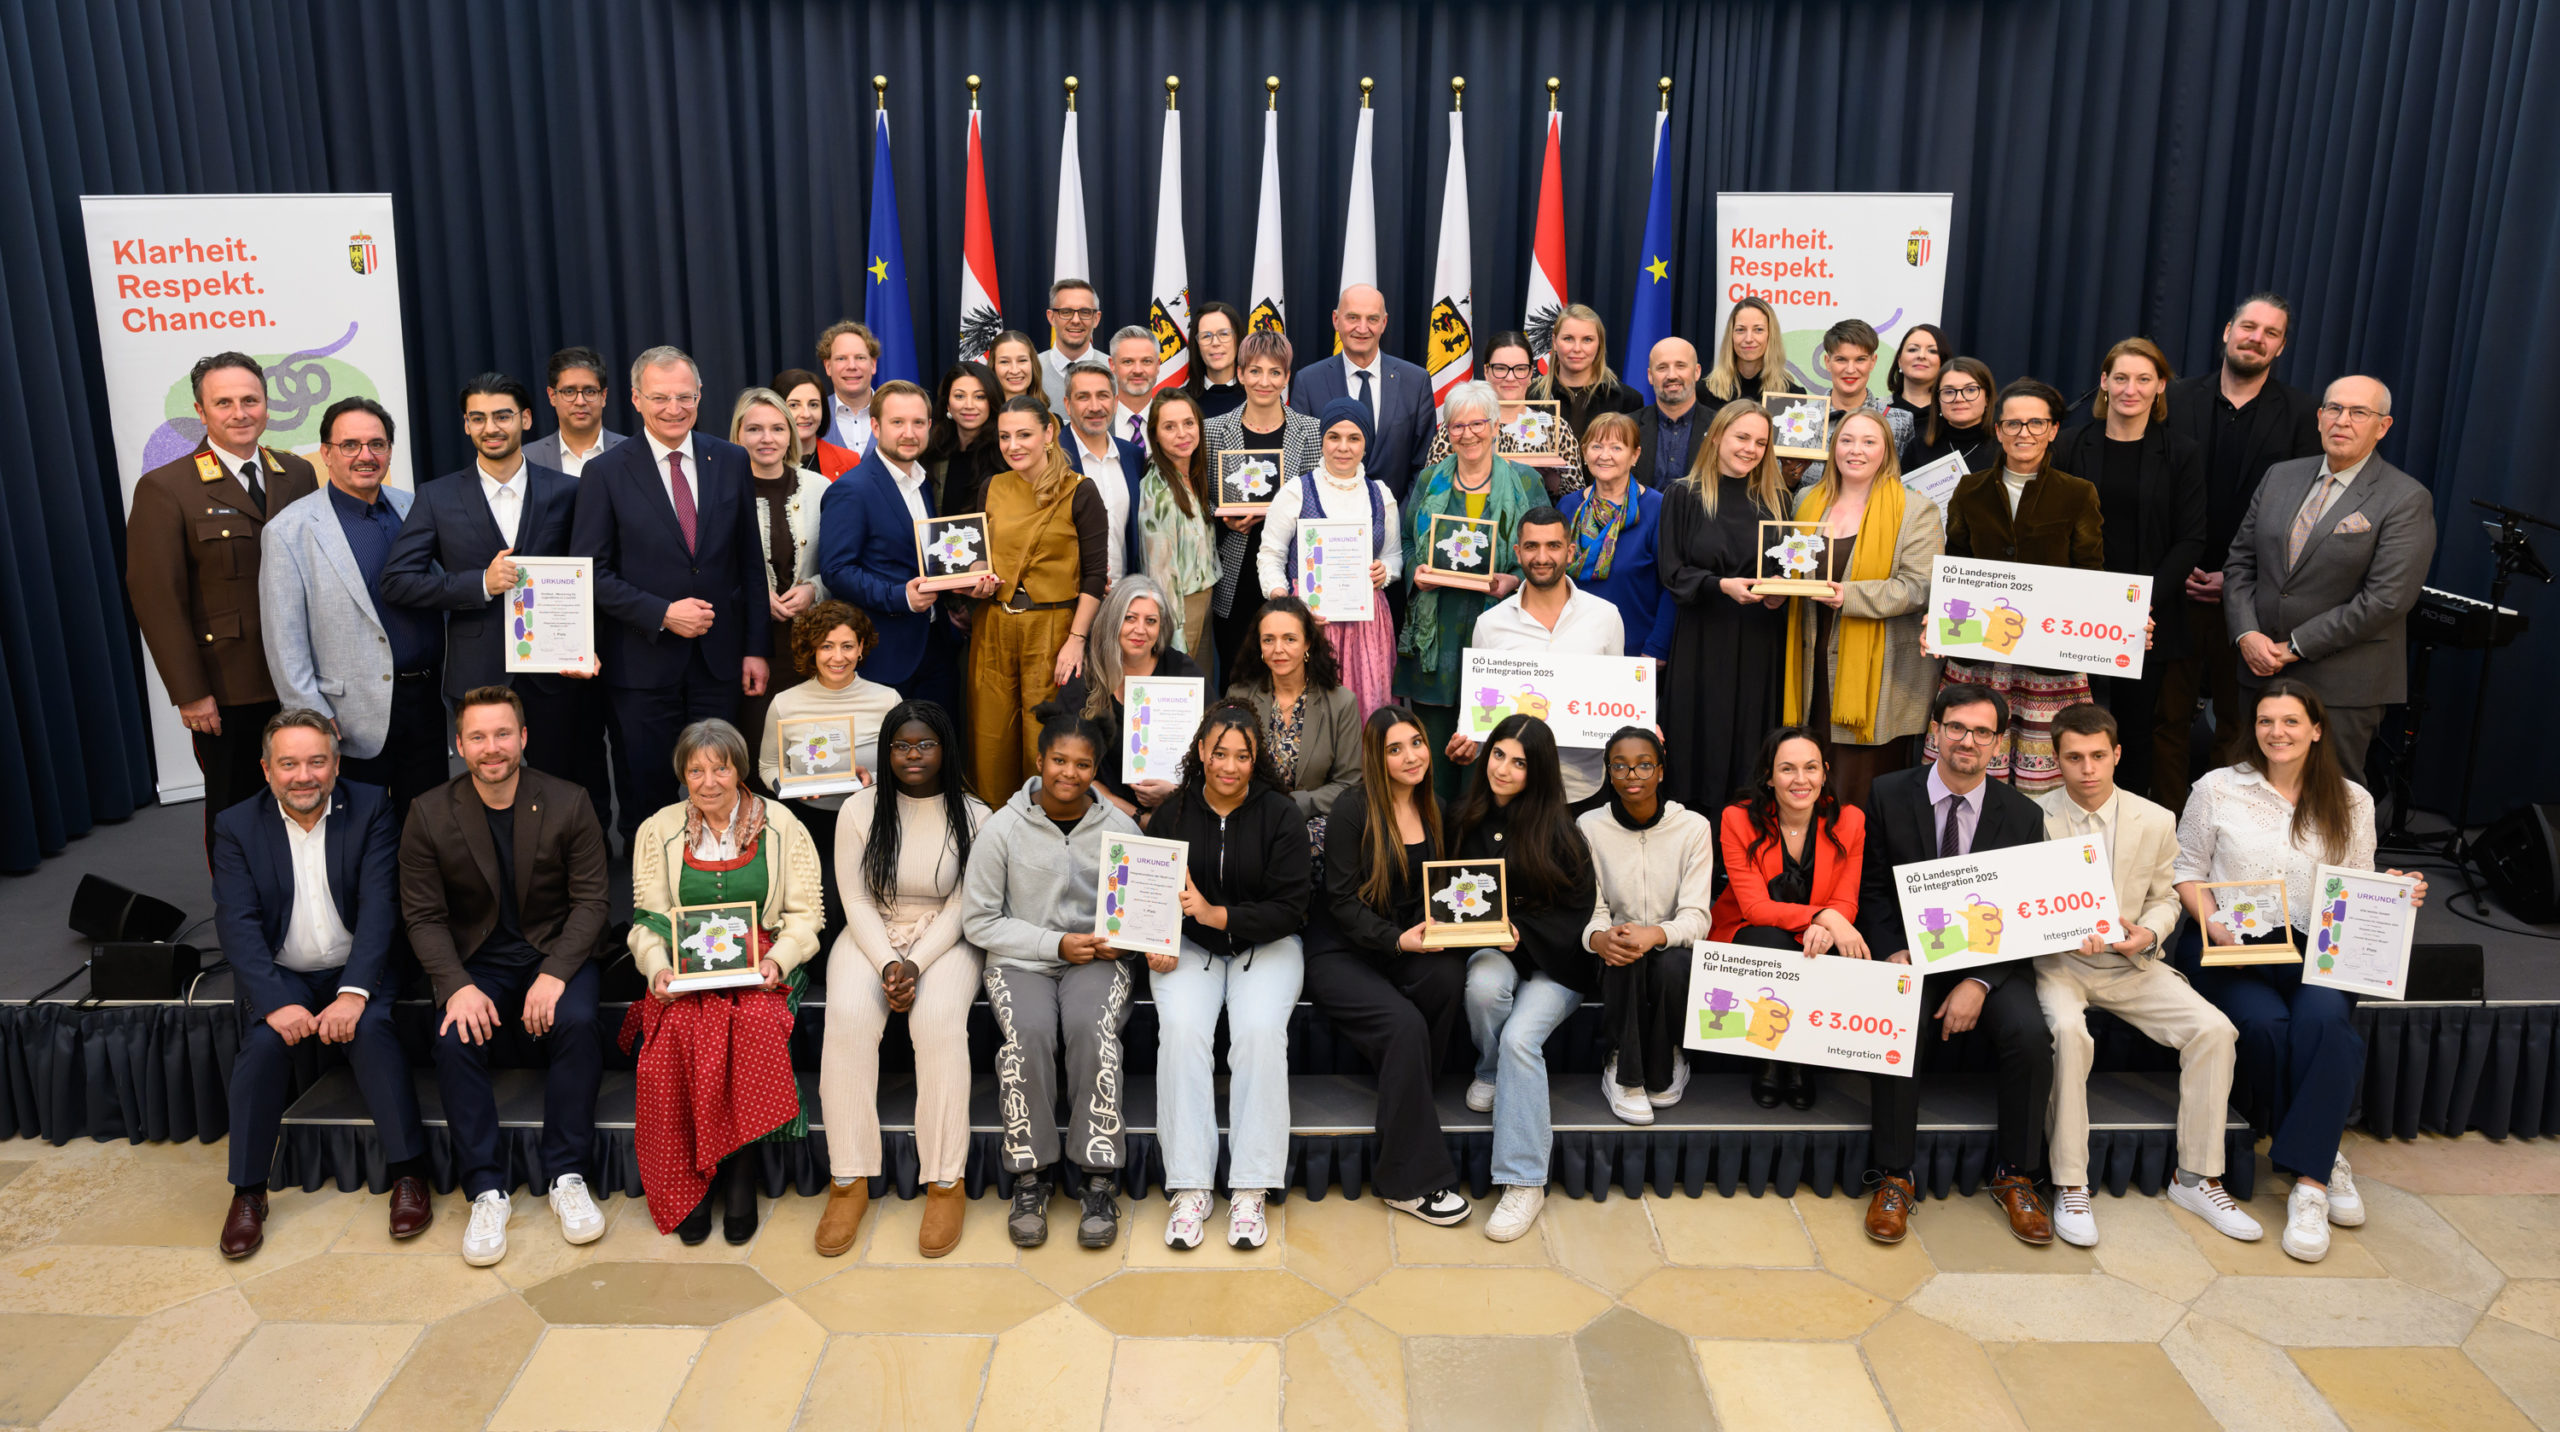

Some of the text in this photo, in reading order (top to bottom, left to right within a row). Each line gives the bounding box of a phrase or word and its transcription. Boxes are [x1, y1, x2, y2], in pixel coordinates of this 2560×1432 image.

[1731, 227, 1834, 250] Klarheit.
[113, 237, 258, 265] Klarheit.
[1730, 256, 1834, 282] Respekt.
[117, 270, 265, 303] Respekt.
[122, 306, 276, 333] Chancen.
[1943, 565, 2016, 581] OÖ Landespreis
[1942, 575, 2033, 592] für Integration 2025
[2041, 617, 2136, 644] € 3.000,-
[1472, 657, 1539, 668] OÖ Landespreis
[2059, 650, 2112, 664] Integration
[1472, 666, 1554, 677] für Integration 2025
[1567, 700, 1647, 721] € 1.000,-
[1136, 857, 1170, 867] URKUNDE
[1906, 865, 1979, 884] OÖ Landespreis
[1908, 871, 1998, 894] für Integration 2025
[2017, 891, 2106, 919] € 3.000,-
[2357, 892, 2397, 904] URKUNDE
[2043, 926, 2094, 942] Integration
[1704, 951, 1782, 969] OÖ Landespreis
[1703, 962, 1800, 981] für Integration 2025
[1808, 1010, 1906, 1040] € 3.000,-
[1827, 1046, 1882, 1061] Integration
